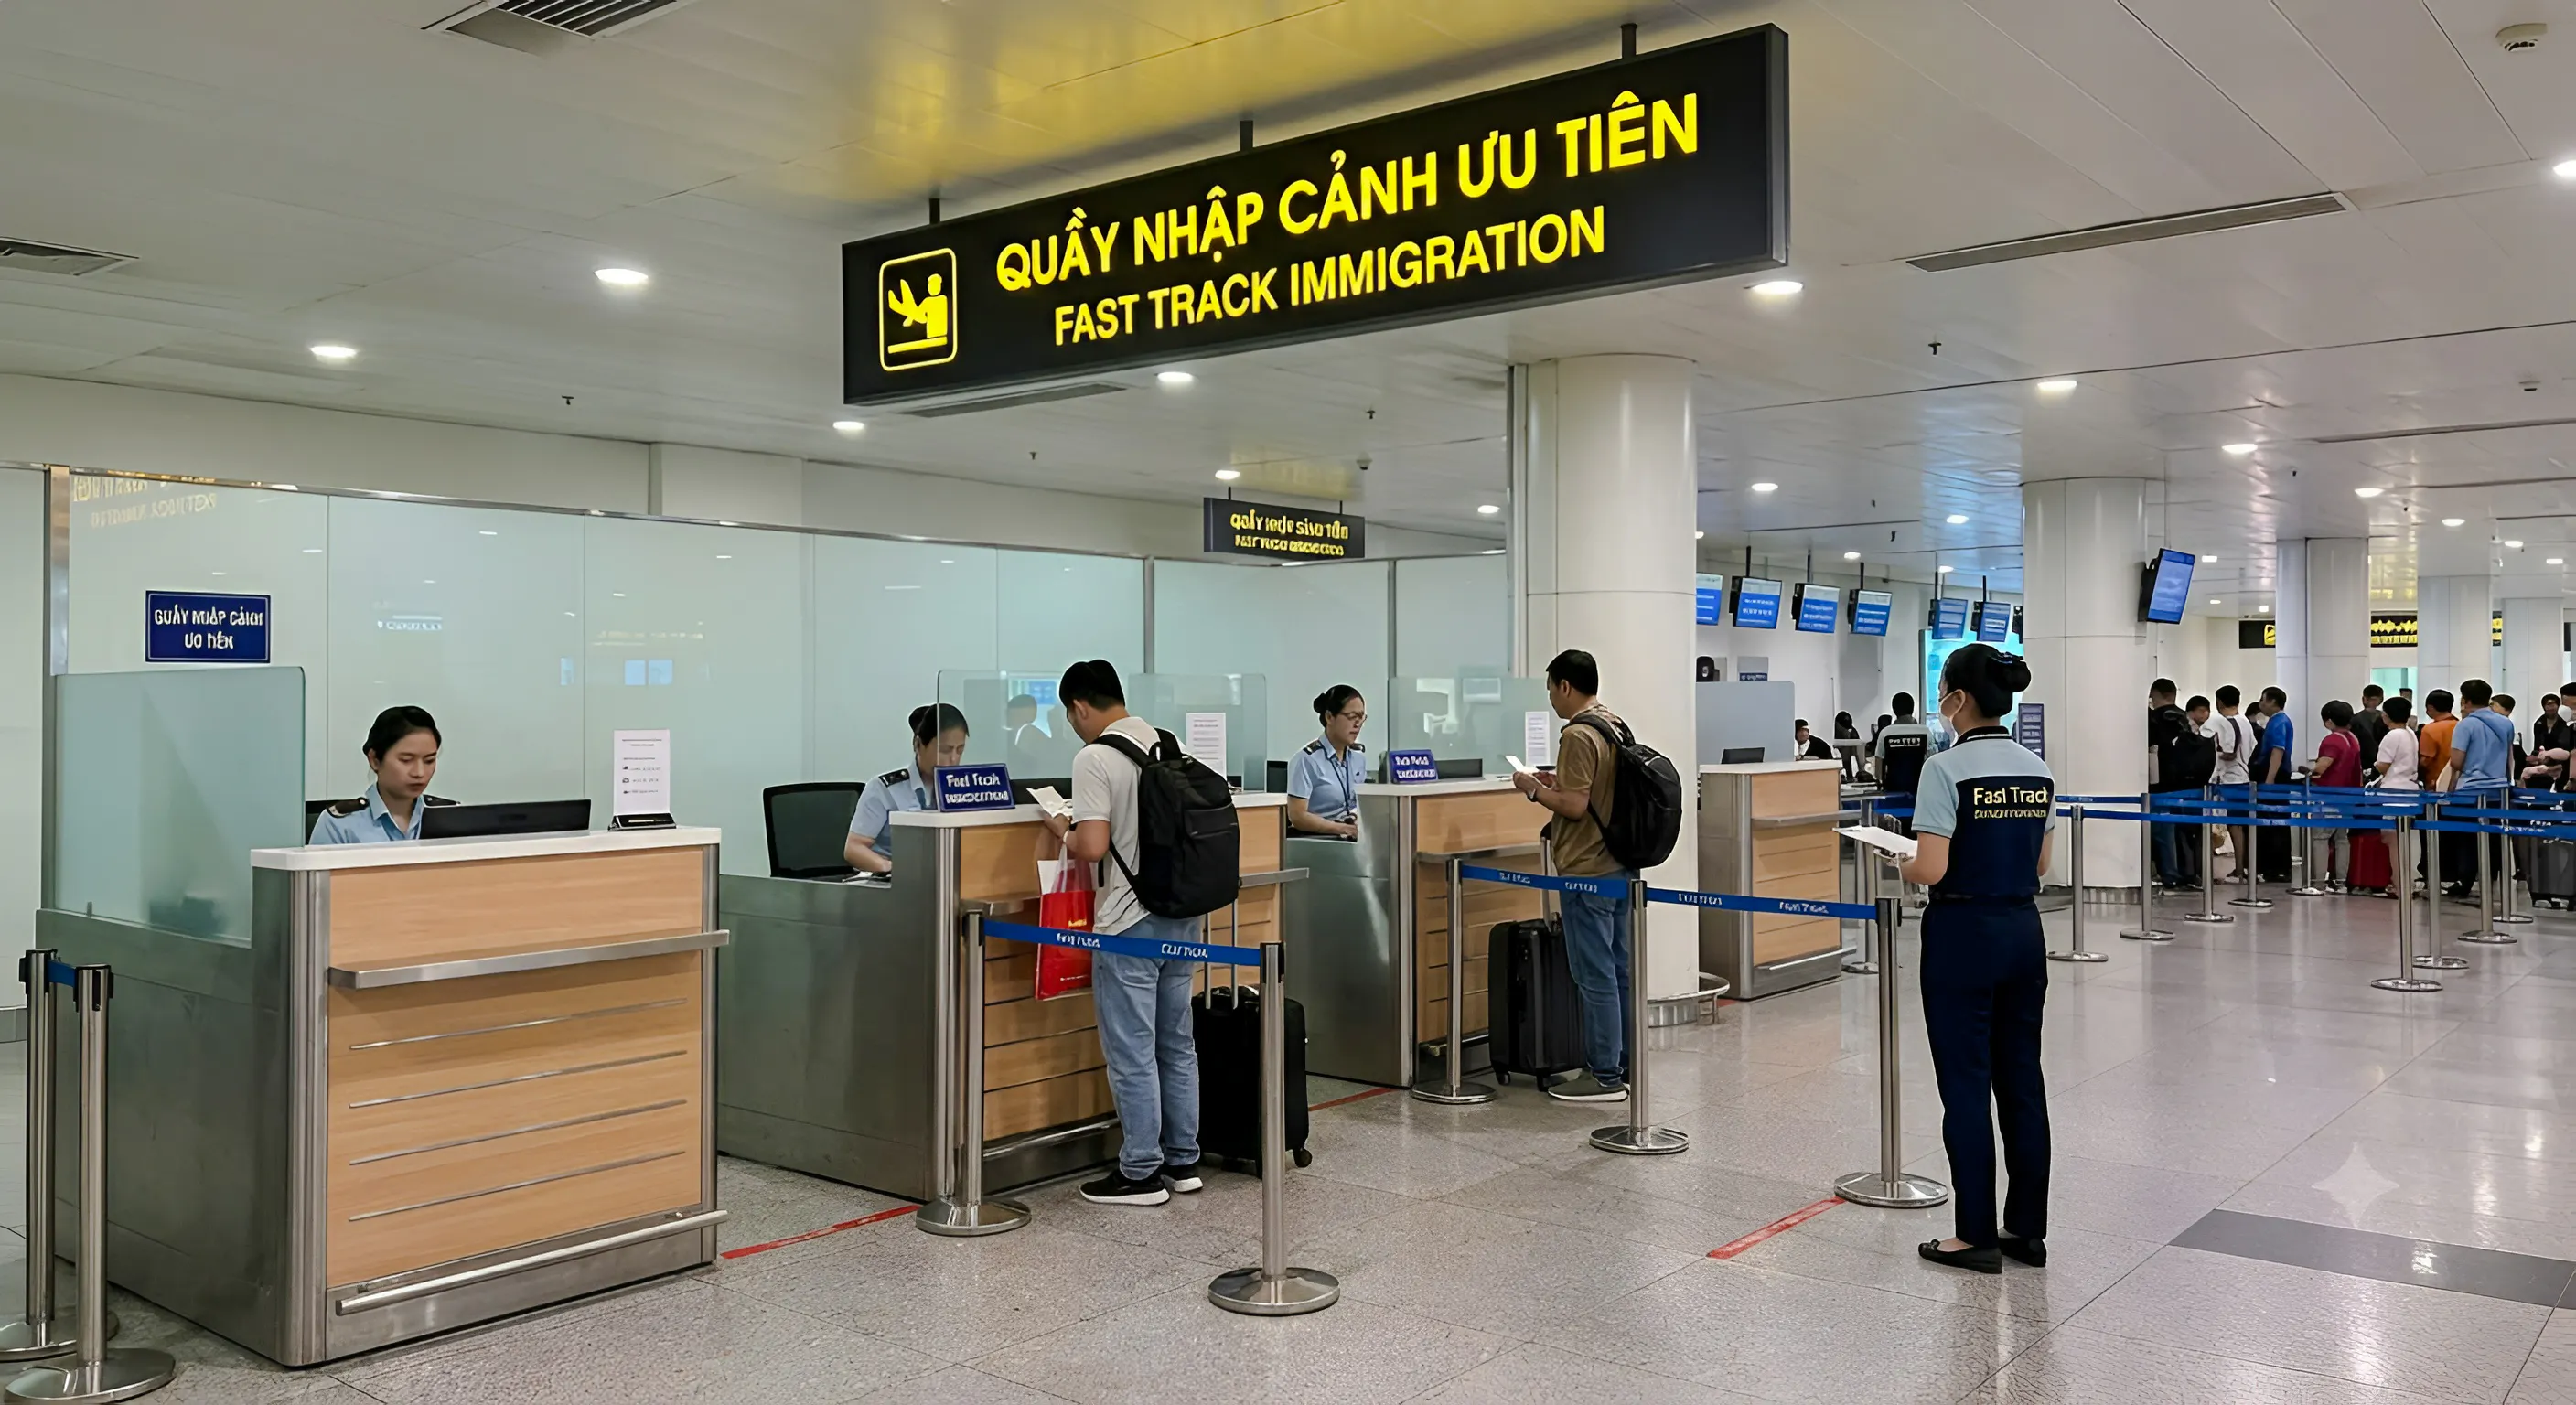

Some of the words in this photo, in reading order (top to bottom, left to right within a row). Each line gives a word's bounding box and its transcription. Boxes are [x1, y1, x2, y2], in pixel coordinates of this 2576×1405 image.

[996, 206, 1121, 292] QUẦY
[1133, 185, 1264, 266] NHẬP
[1278, 149, 1438, 235] CẢNH
[1458, 129, 1537, 198] ƯU
[1555, 90, 1698, 177] TIÊN
[1055, 293, 1141, 347] FAST
[1146, 267, 1279, 330] TRACK
[1290, 205, 1605, 306] IMMIGRATION
